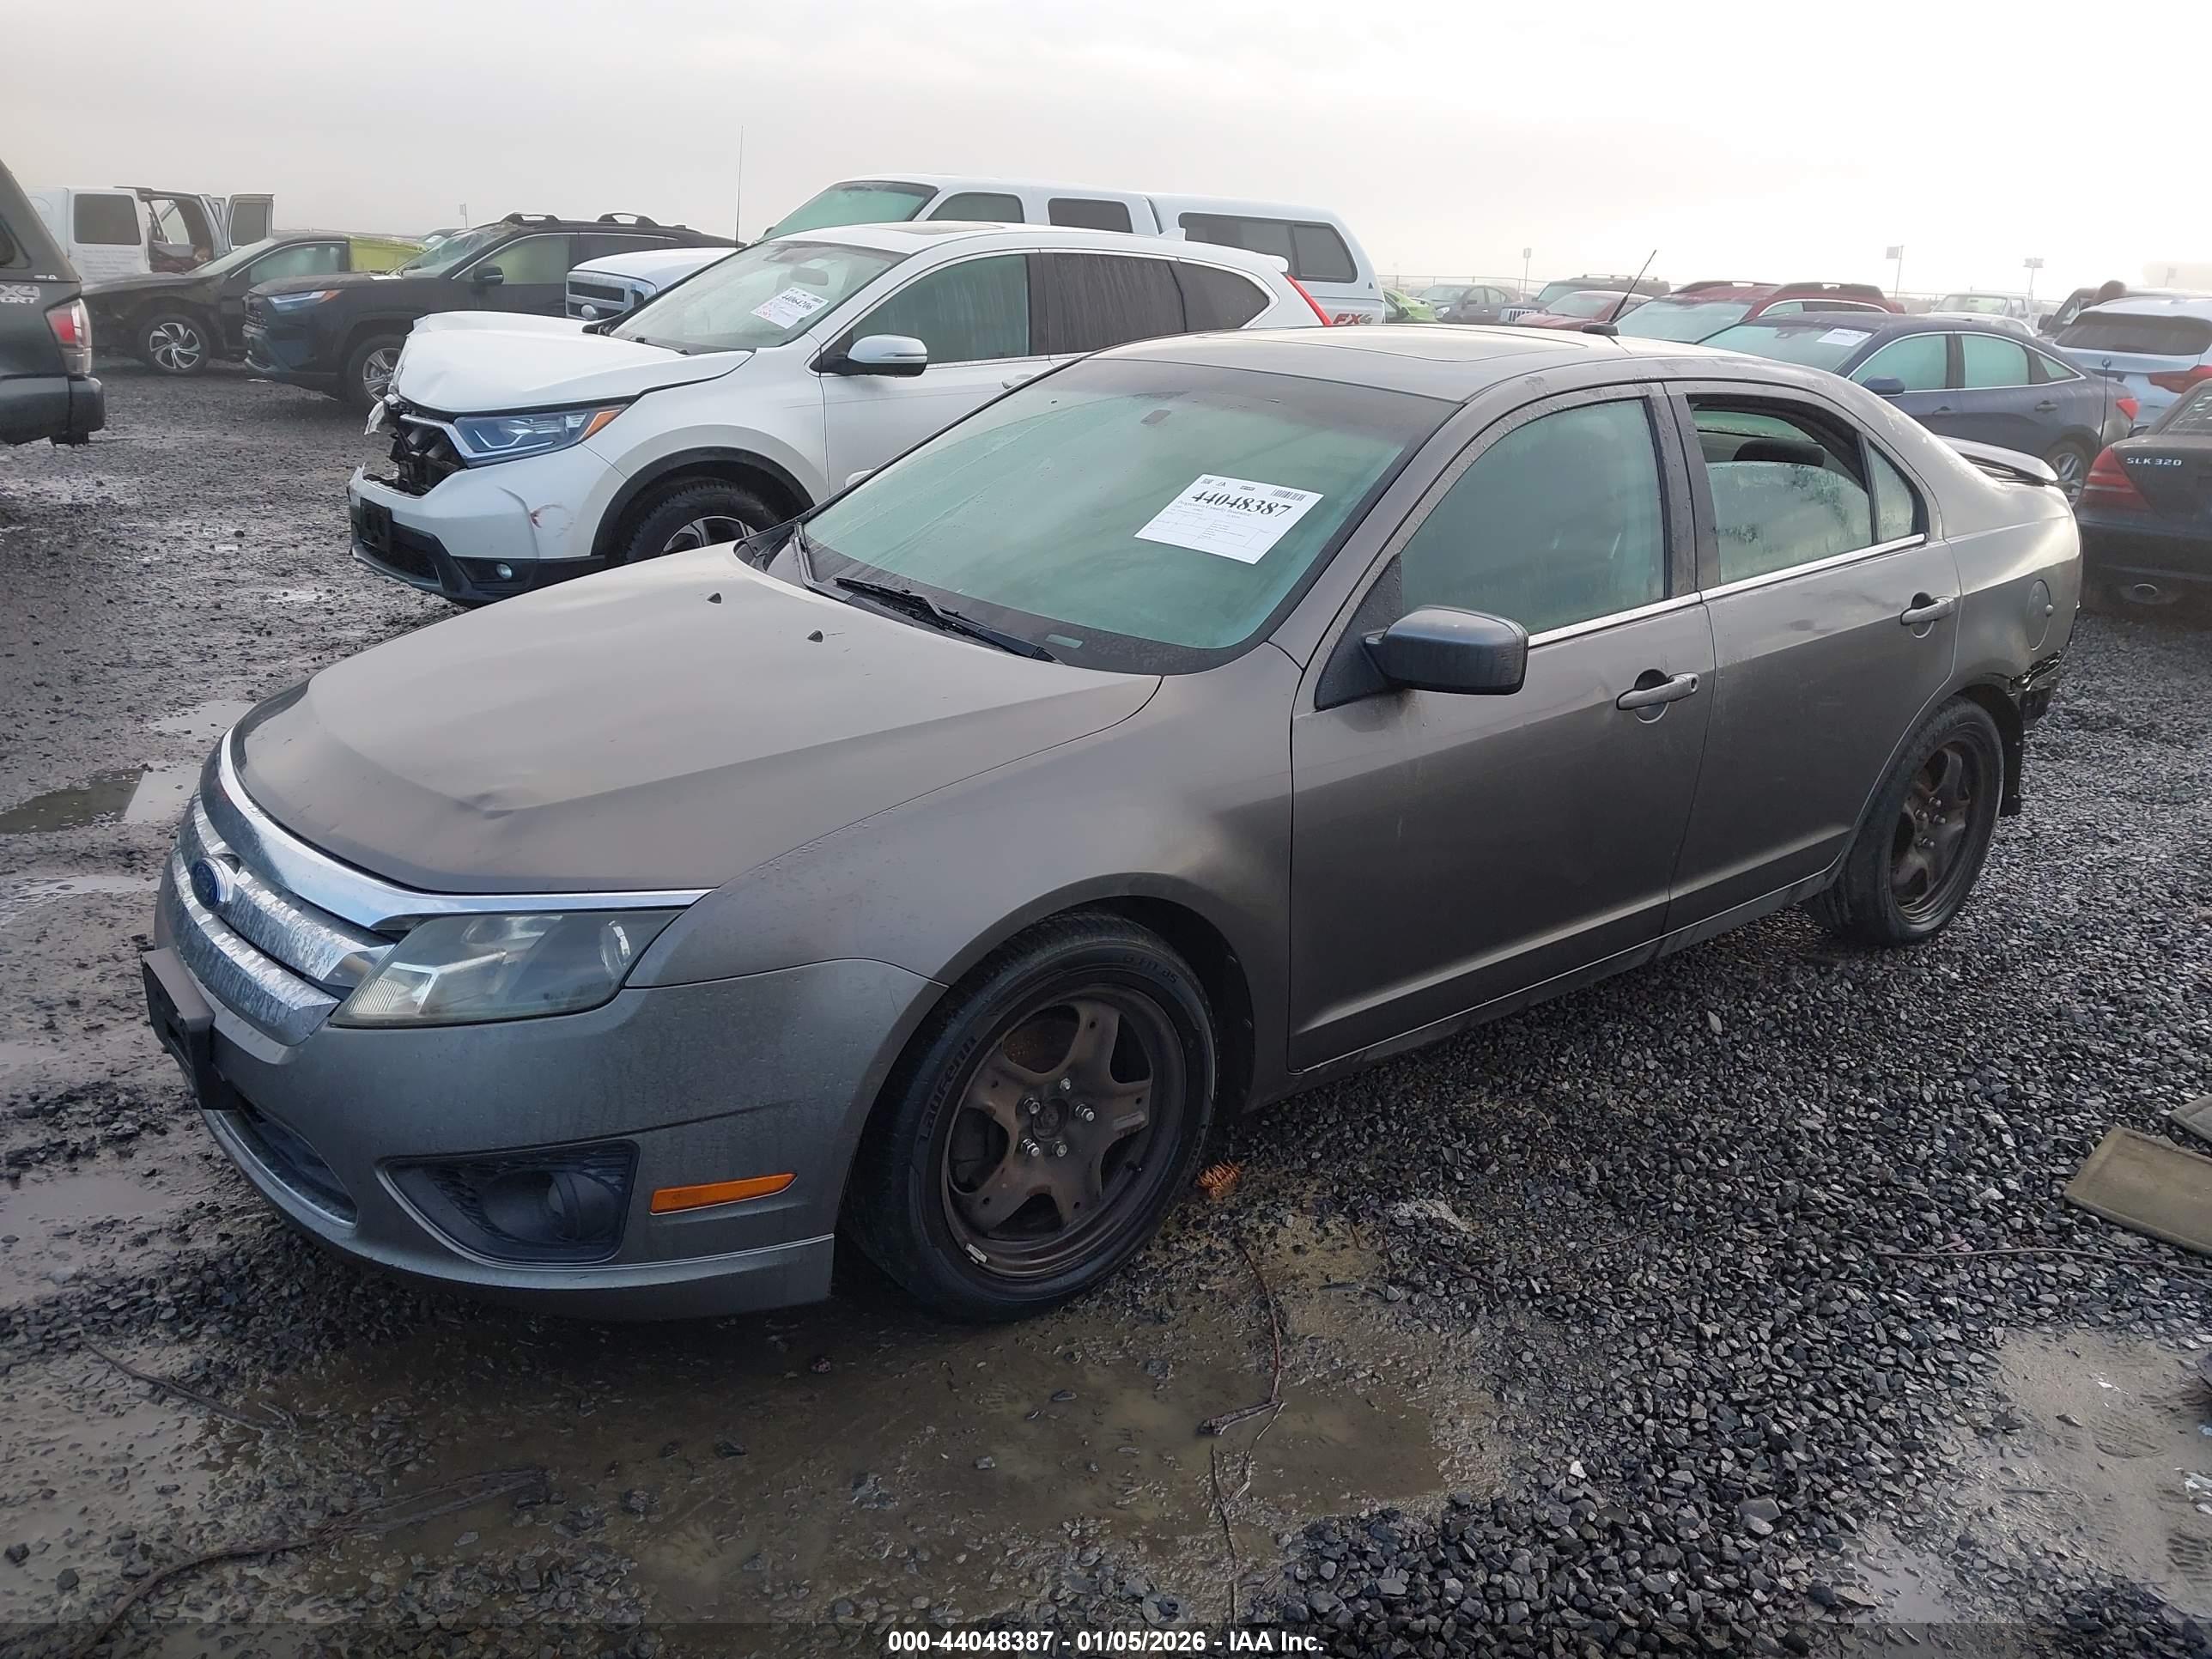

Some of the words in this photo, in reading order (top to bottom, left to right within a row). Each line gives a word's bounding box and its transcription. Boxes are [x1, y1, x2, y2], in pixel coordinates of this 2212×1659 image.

[0, 284, 40, 297] X4
[1333, 313, 1373, 324] FX4
[2154, 458, 2183, 466] 320
[1191, 490, 1293, 518] 44048387
